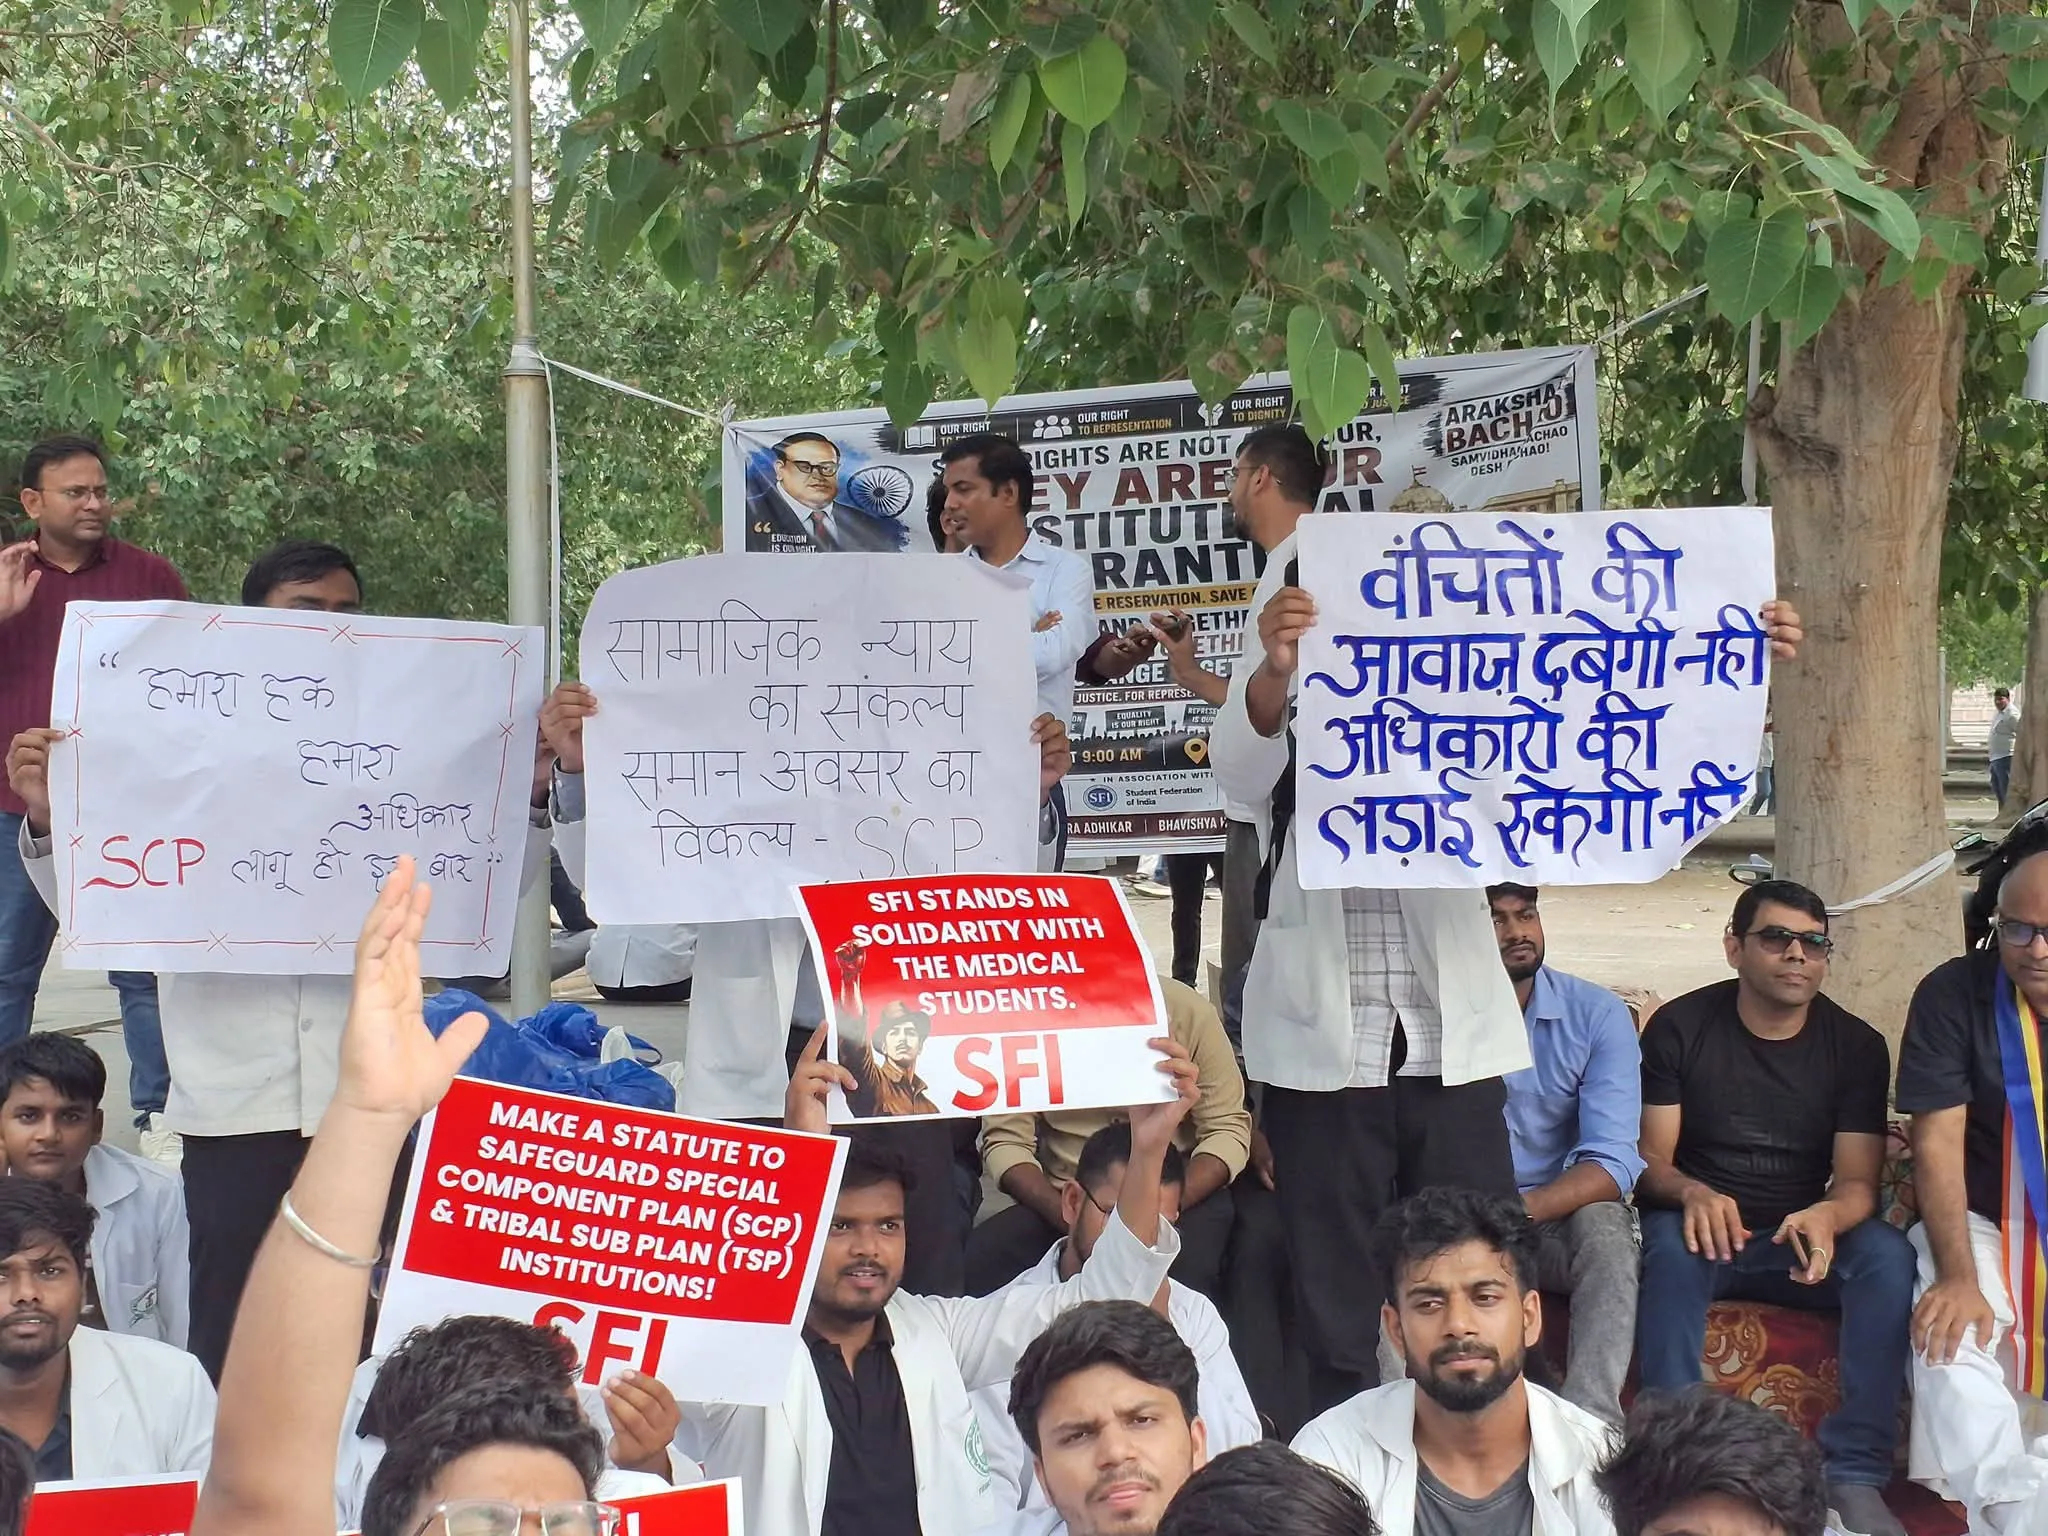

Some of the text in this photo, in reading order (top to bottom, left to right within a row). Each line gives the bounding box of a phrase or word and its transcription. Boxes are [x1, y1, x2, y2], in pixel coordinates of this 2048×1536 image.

[1077, 409, 1130, 423] OUR RIGHT
[1231, 396, 1285, 411] OUR RIGHT
[1232, 408, 1287, 423] TO DIGNITY
[1445, 382, 1561, 426] ARAKSHA
[940, 421, 991, 435] OUR RIGHT
[1078, 418, 1172, 435] TO REPRESENTATION
[1119, 440, 1169, 464] ARE
[1180, 435, 1232, 458] NOT
[1112, 459, 1232, 506] ARE
[1471, 461, 1502, 476] DESH
[1360, 519, 1683, 620] वंचितों की
[1107, 592, 1206, 609] RESERVATION.
[1210, 588, 1247, 603] SAVE
[606, 599, 979, 682] सामाजिक न्याय
[1532, 609, 1682, 701] दबेगी
[138, 667, 245, 717] हमारा
[261, 673, 335, 721] हक
[749, 674, 974, 742] का संकल्प
[1076, 691, 1122, 703] JUSTICE.
[1125, 690, 1145, 701] FOR
[1576, 691, 1674, 771] की
[296, 739, 401, 785] हमारा
[1082, 750, 1115, 763] 9:00
[1119, 748, 1142, 761] AM
[622, 751, 982, 812] समान अवसर का
[1118, 773, 1187, 783] ASSOCIATION
[1125, 786, 1203, 797] Student Federation
[1089, 790, 1111, 803] SFI
[1126, 798, 1156, 807] of India
[328, 792, 480, 844] अधिकार
[1084, 821, 1133, 834] ADHIKAR
[1158, 816, 1217, 832] BHAVISHYA
[651, 809, 796, 867] विकल्प
[81, 835, 206, 890] SCP
[231, 849, 304, 896] लागू
[313, 838, 352, 880] हो
[429, 853, 474, 882] बार
[867, 887, 1069, 913] SFI STANDS IN
[852, 917, 1104, 947] SOLIDARITY WITH
[893, 951, 1084, 981] THE MEDICAL
[917, 986, 1076, 1017] STUDENTS.
[951, 1033, 1064, 1111] SFI
[489, 1102, 786, 1170] MAKE A STATUTE TO
[477, 1135, 781, 1205] SAFEGUARD SPECIAL
[437, 1164, 803, 1247] COMPONENT PLAN (SCP)
[430, 1199, 795, 1279] & TRIBAL SUB PLAN (TSP)
[500, 1246, 717, 1301] INSTITUTIONS!
